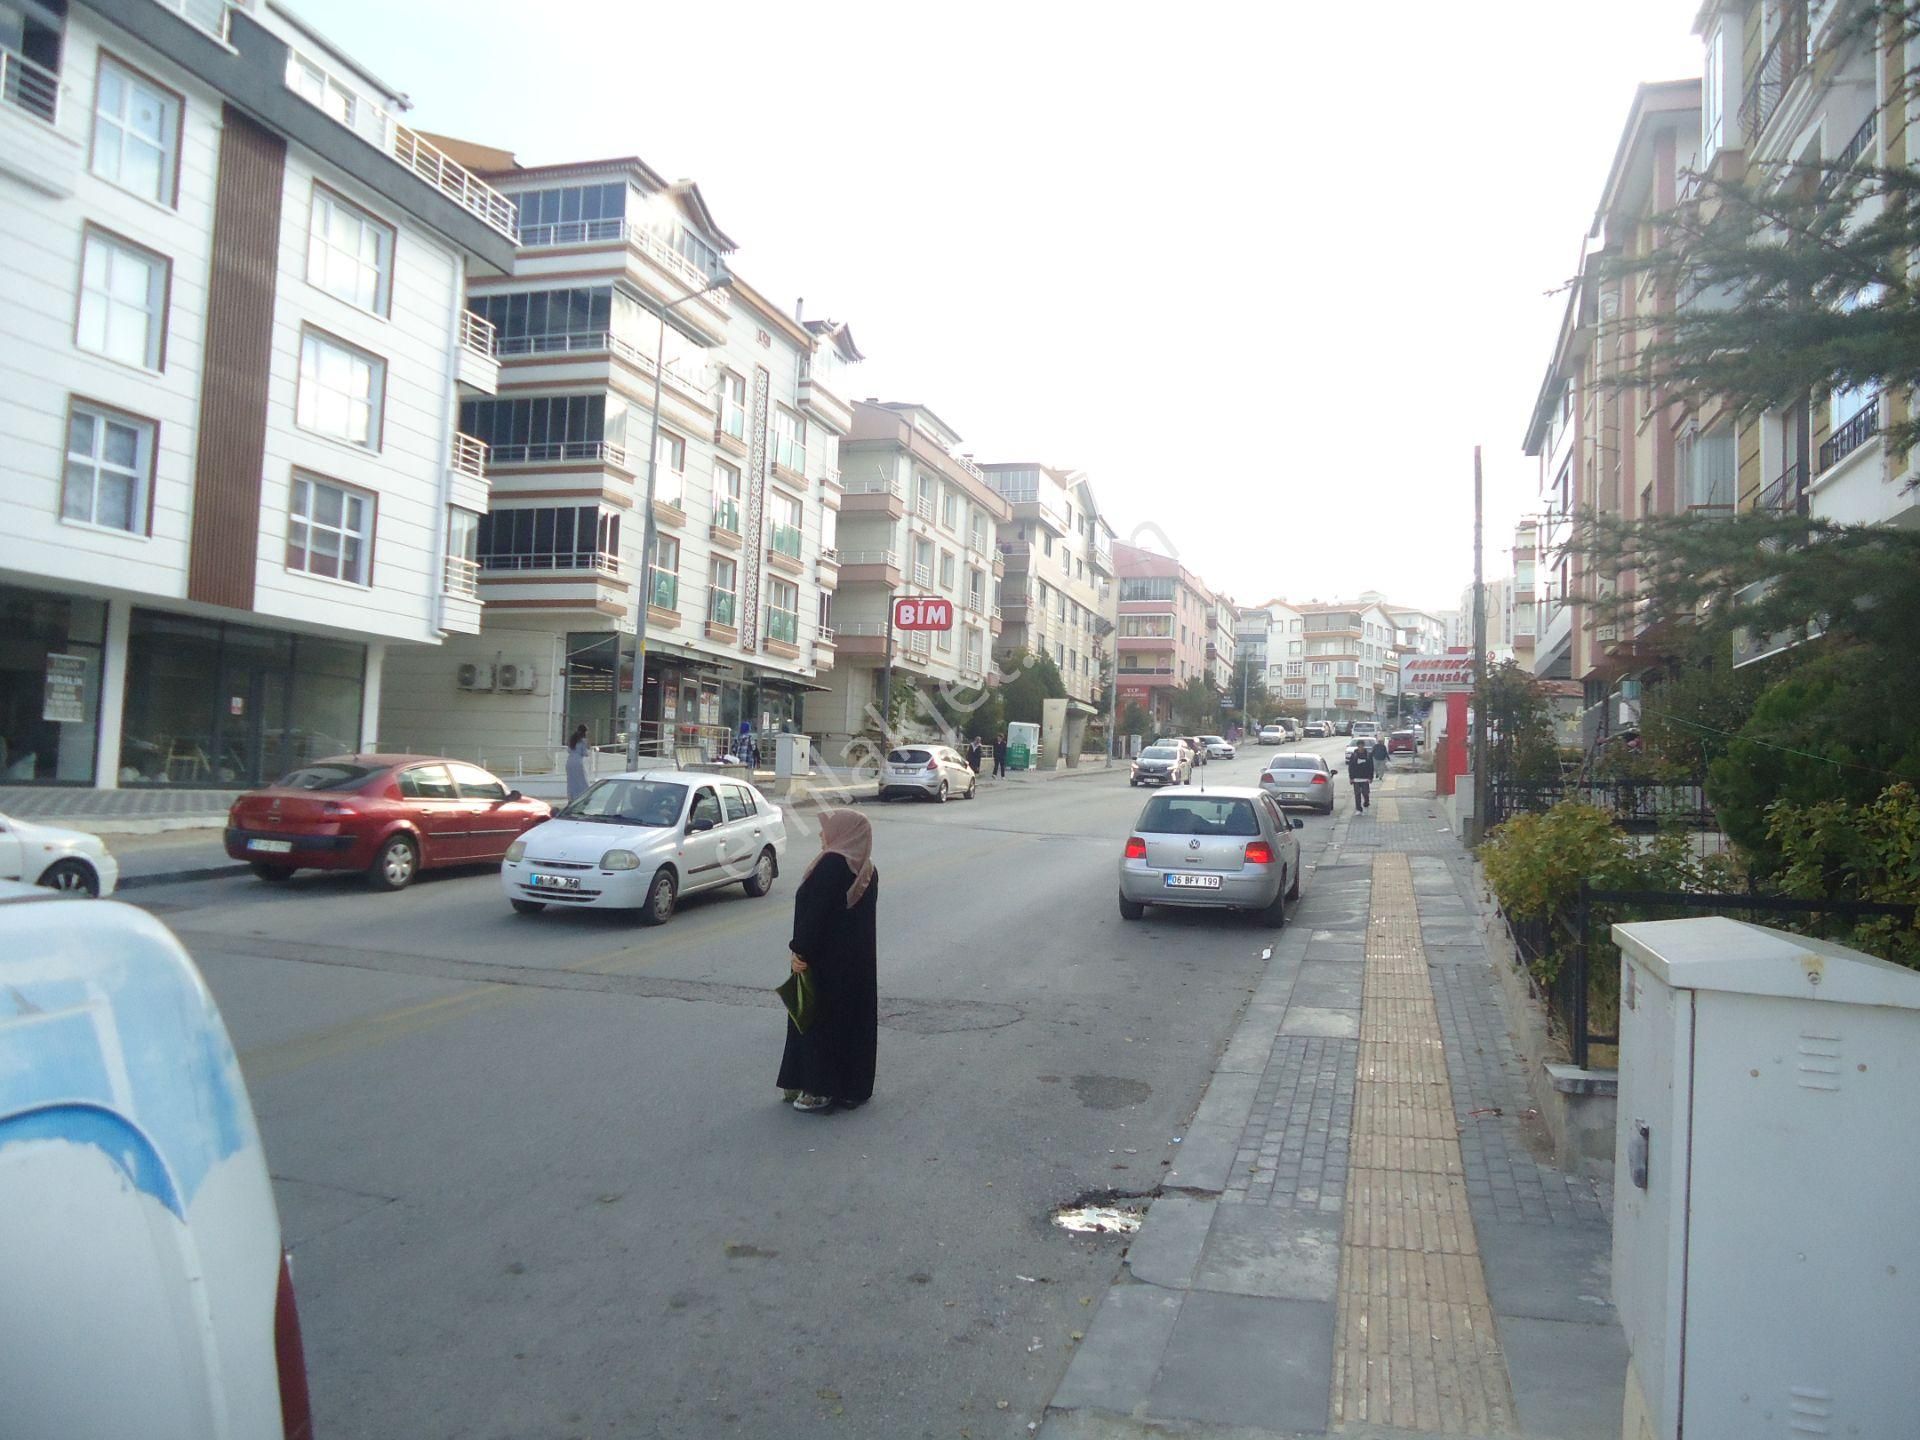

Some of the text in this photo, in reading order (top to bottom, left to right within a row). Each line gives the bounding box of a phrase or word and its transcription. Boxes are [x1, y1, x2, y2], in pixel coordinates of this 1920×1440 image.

[899, 601, 946, 625] BİM
[1172, 875, 1182, 884] 06
[1203, 877, 1218, 886] 199
